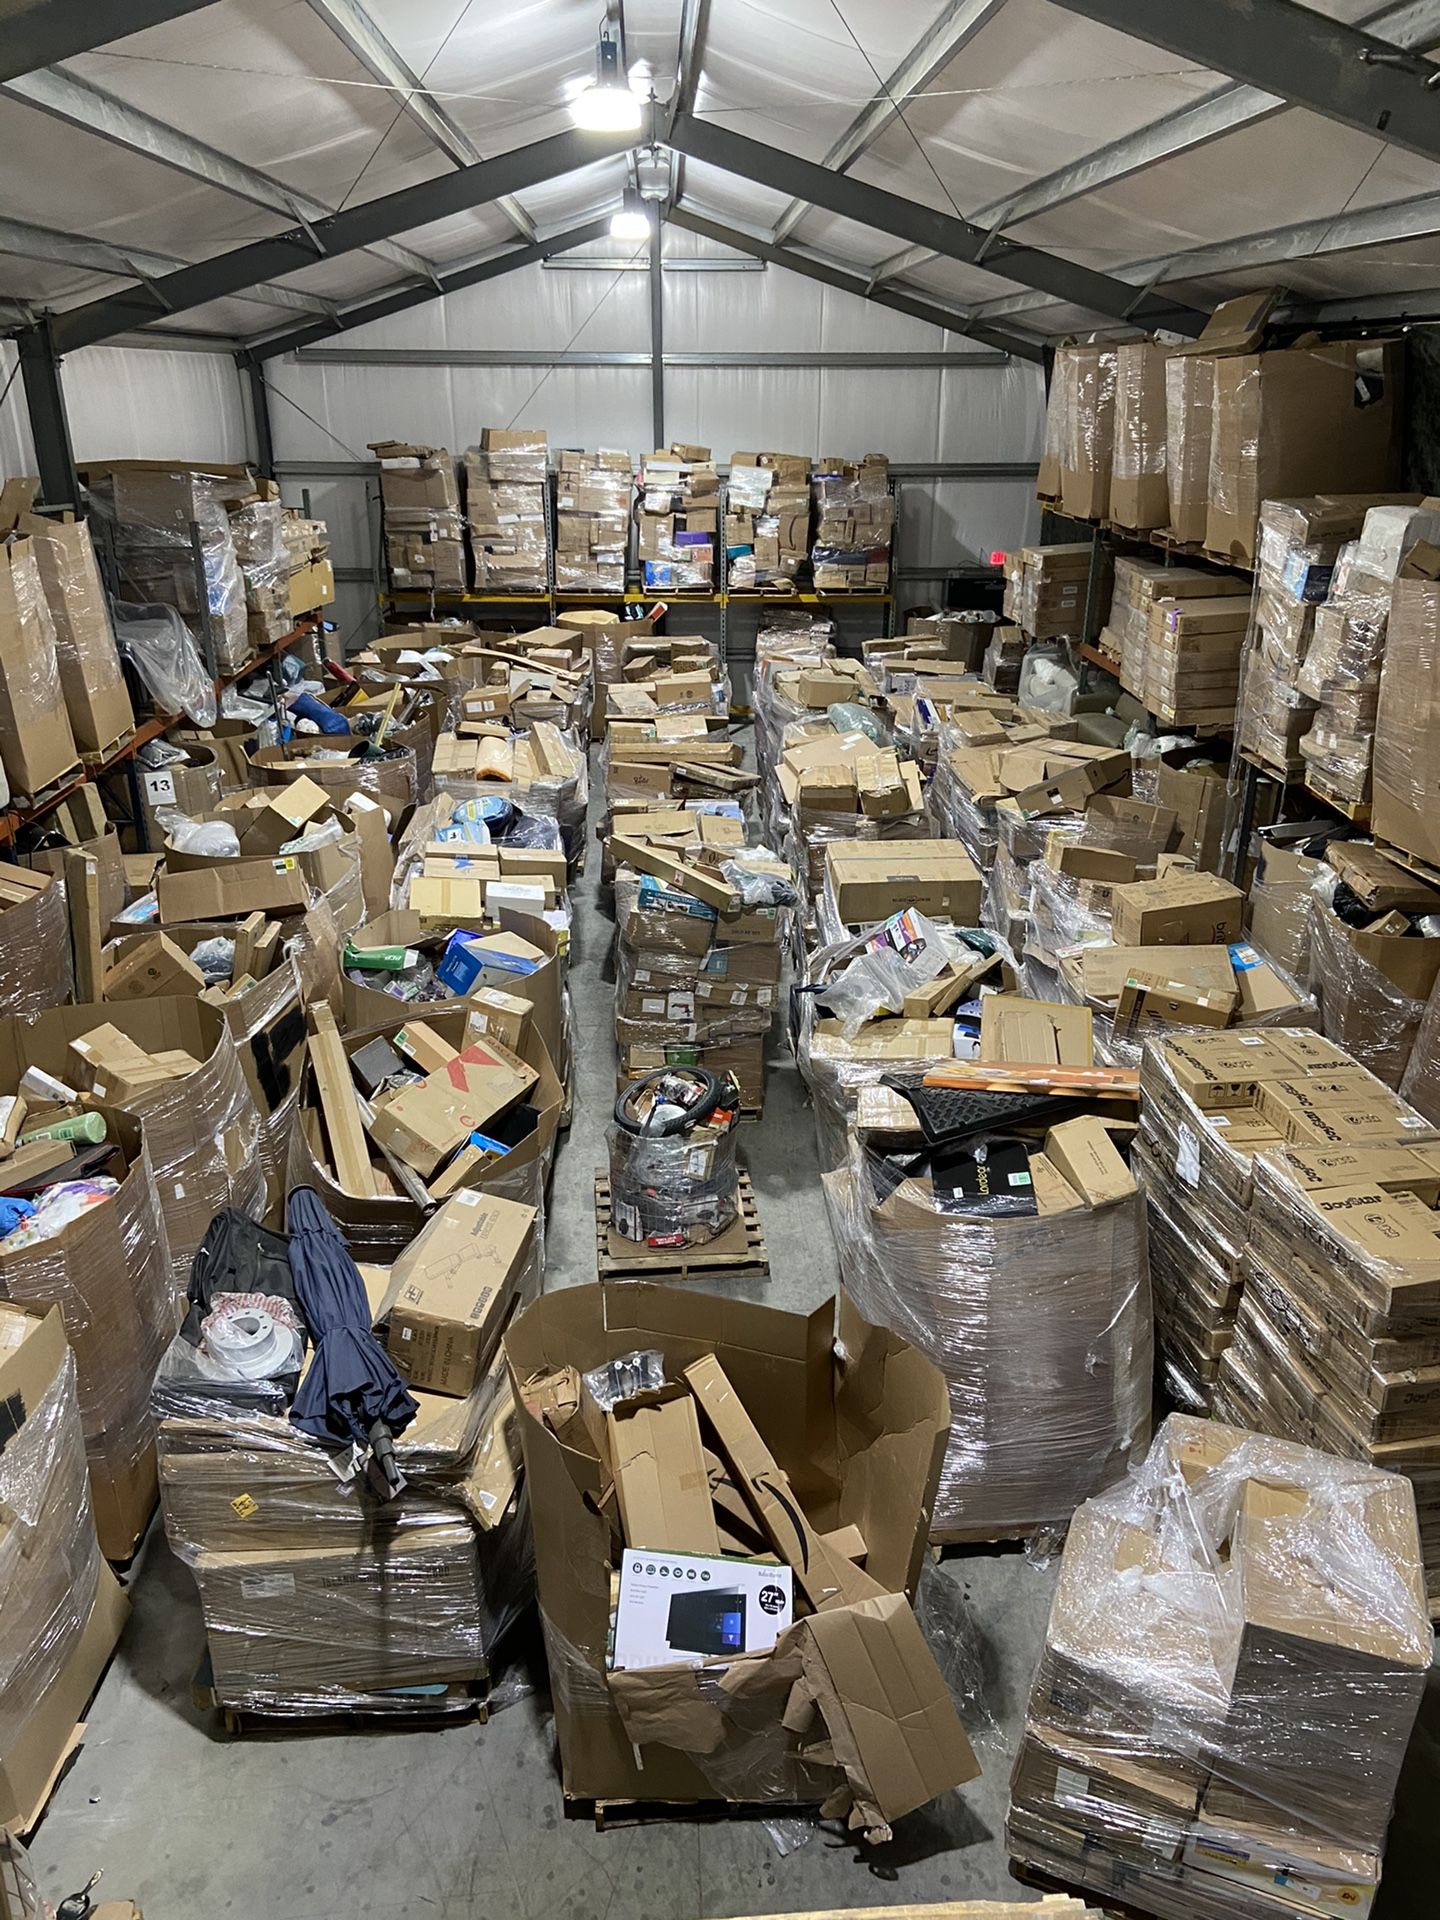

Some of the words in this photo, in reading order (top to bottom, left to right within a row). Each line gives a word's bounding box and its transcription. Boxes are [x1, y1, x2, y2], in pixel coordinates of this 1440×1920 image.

[150, 780, 170, 791] 13
[654, 892, 682, 902] UNIVERSAL
[486, 1038, 537, 1078] MACLAREN
[1185, 1056, 1218, 1081] JoyStar
[1307, 1061, 1358, 1070] JoyStar
[1303, 1110, 1342, 1142] JoyStar
[977, 1165, 989, 1196] Lordear
[1320, 1194, 1383, 1211] JoyStar
[445, 1336, 454, 1357] CHINA
